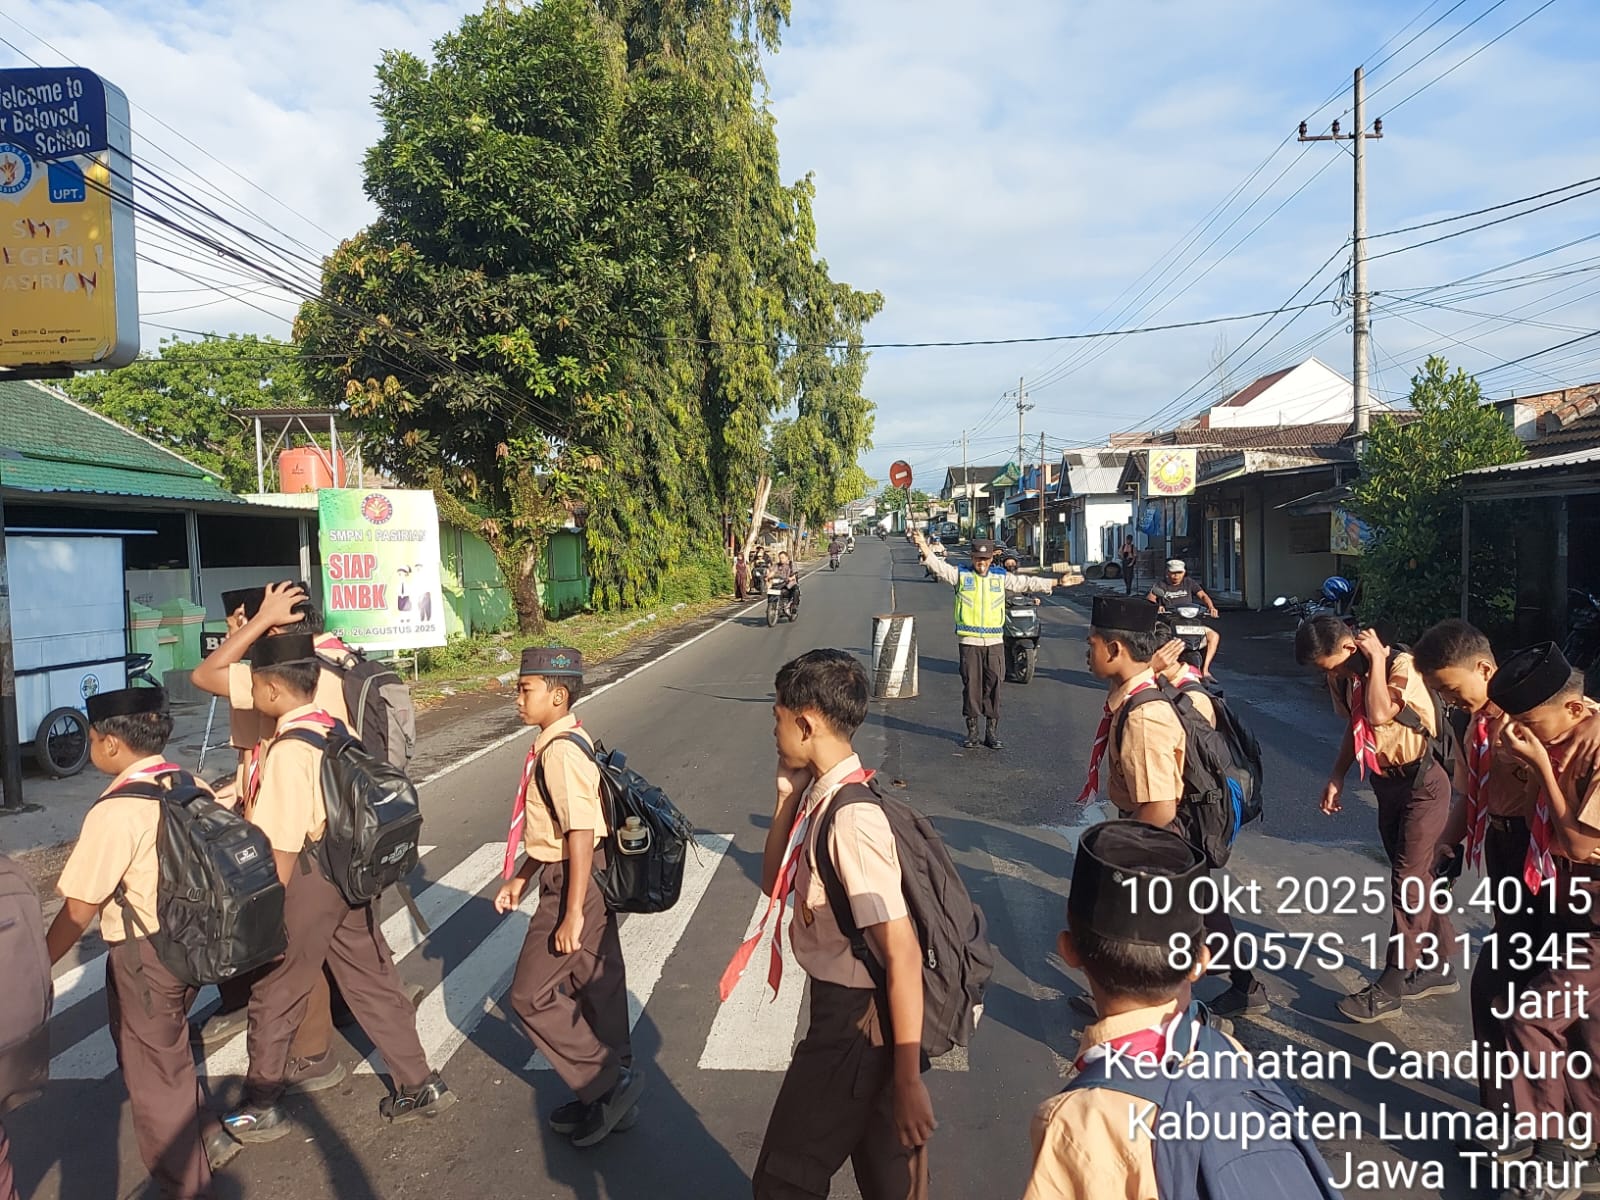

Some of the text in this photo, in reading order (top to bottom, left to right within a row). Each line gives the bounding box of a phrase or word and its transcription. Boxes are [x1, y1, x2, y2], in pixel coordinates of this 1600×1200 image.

[66, 76, 83, 98] to
[12, 100, 79, 133] Beloved
[329, 529, 363, 541] SMPN
[366, 530, 372, 541] 1
[328, 554, 377, 580] SIAP
[330, 584, 387, 610] ANBK
[365, 625, 412, 636] AGUSTUS
[415, 623, 436, 633] 2025
